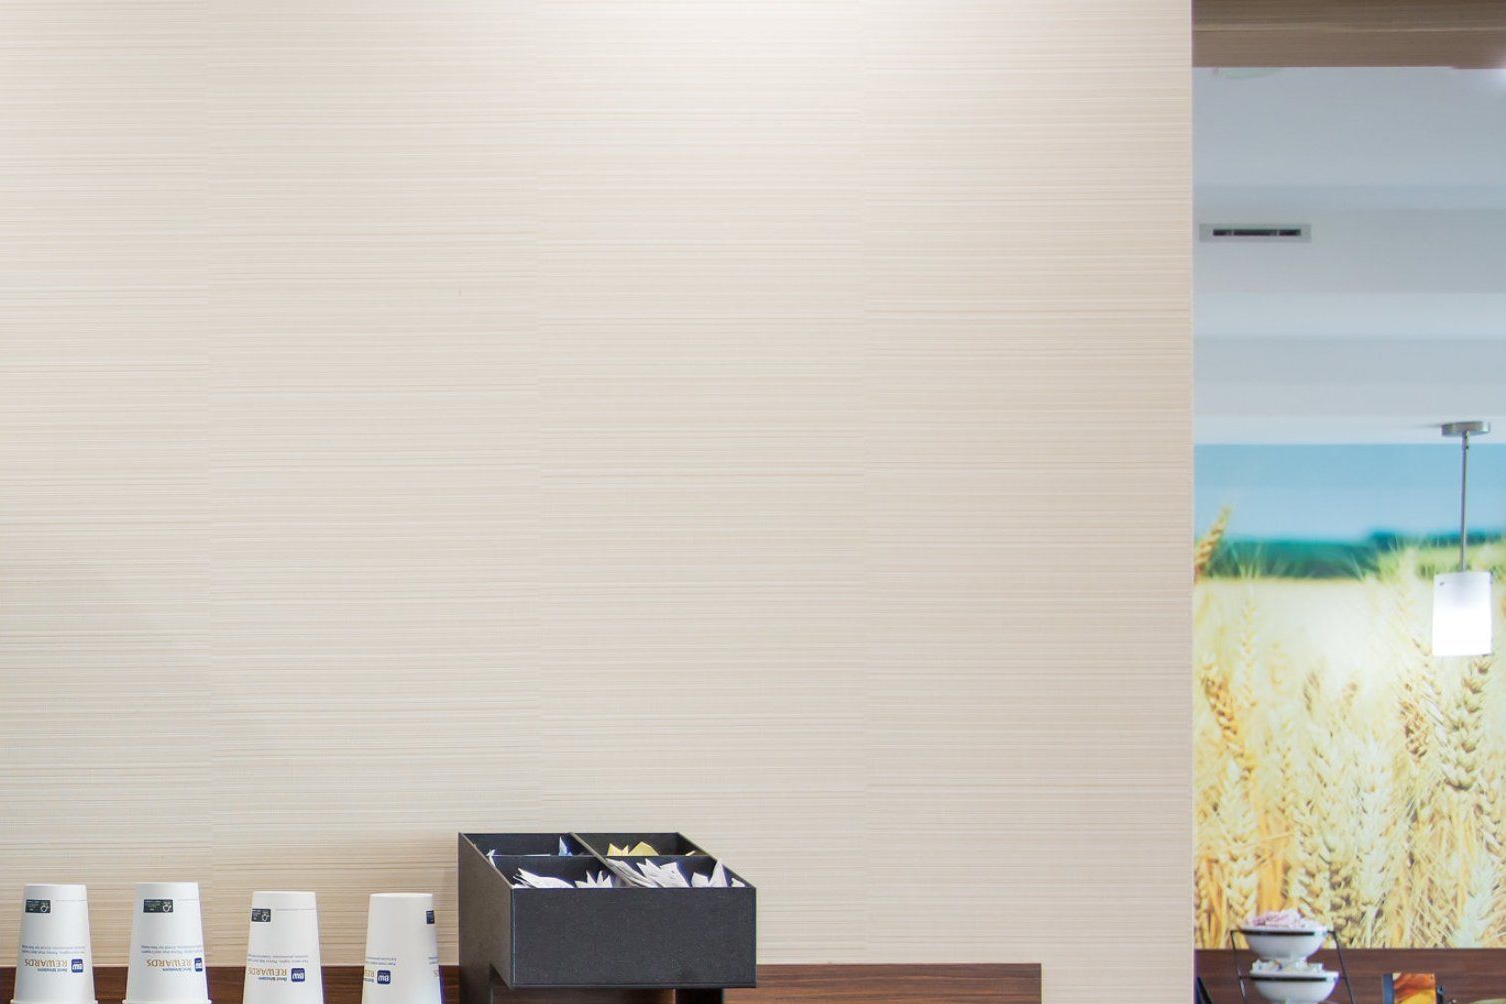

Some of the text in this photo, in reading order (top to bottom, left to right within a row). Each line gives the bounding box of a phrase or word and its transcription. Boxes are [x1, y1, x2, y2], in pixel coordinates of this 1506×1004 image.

[24, 958, 68, 967] REWARDS
[146, 958, 192, 967] REWARDS
[247, 967, 288, 976] REWARDS
